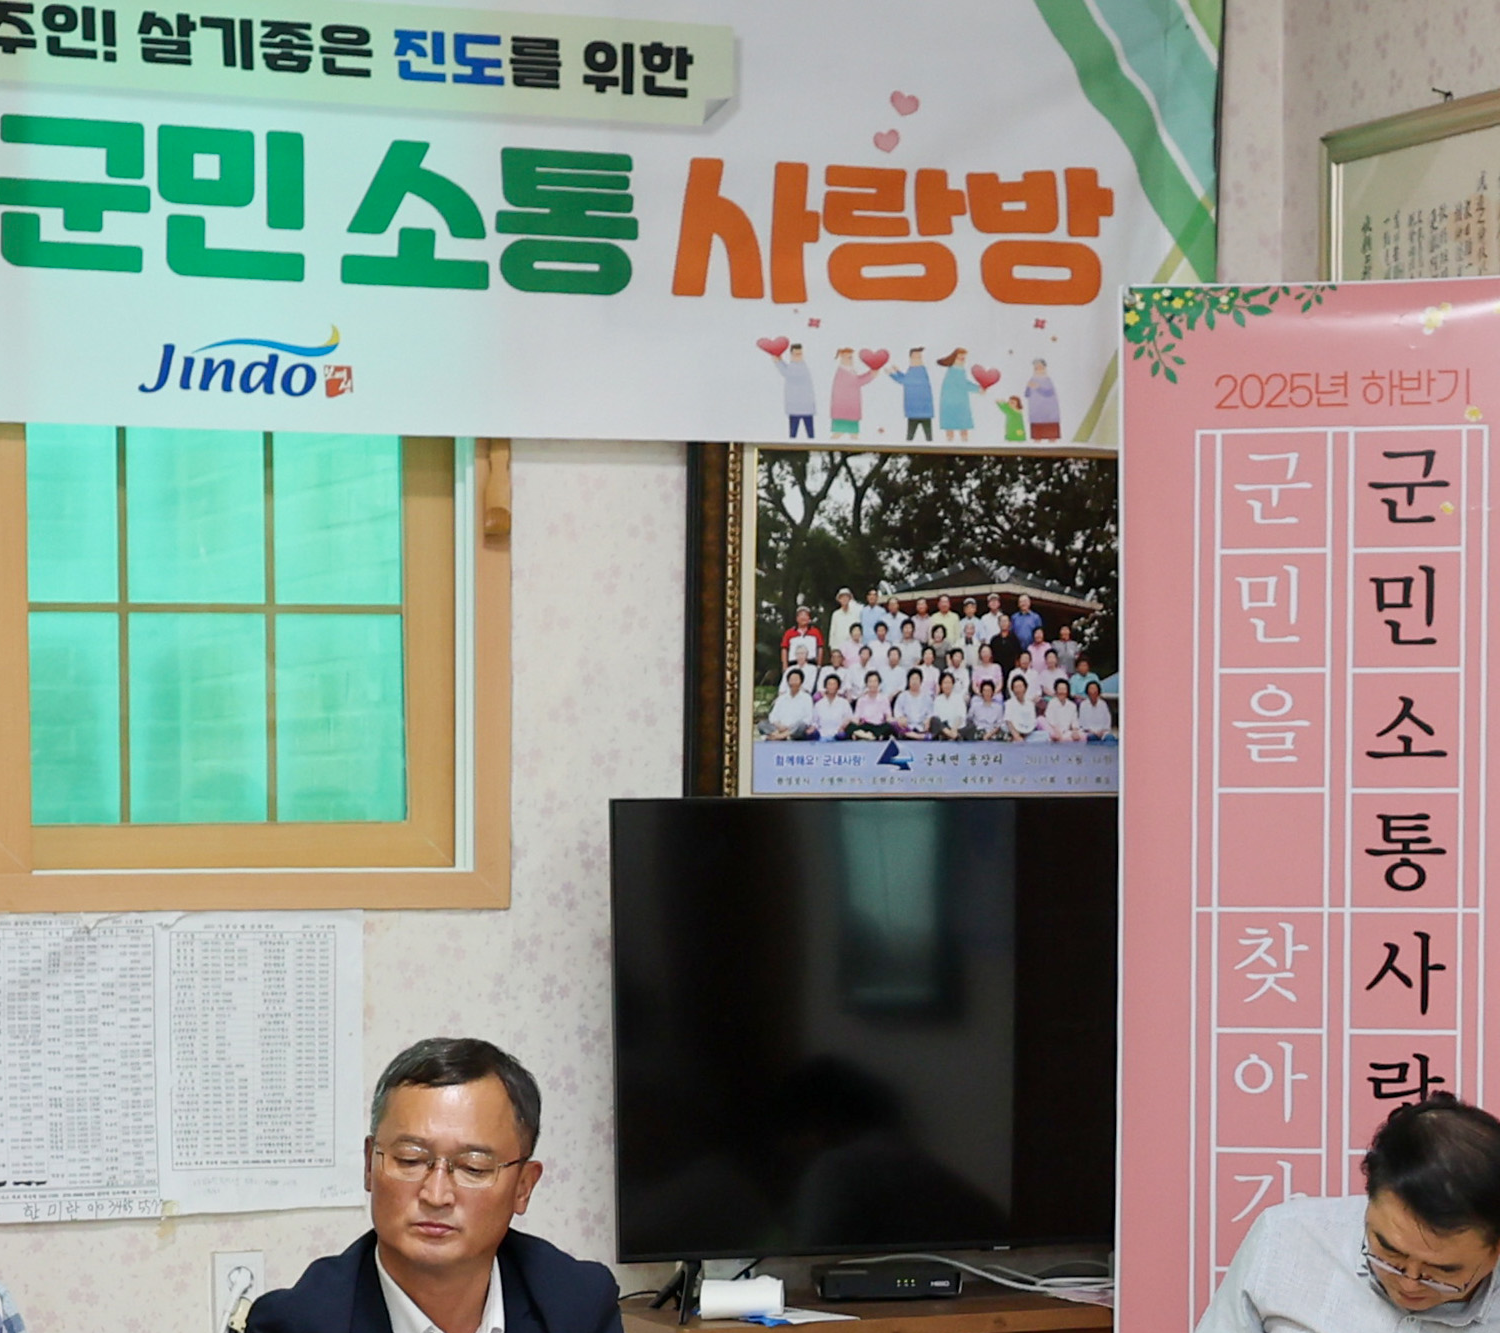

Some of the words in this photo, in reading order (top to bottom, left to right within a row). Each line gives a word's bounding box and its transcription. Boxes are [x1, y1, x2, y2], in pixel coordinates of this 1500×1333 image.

[137, 11, 373, 78] 살기좋은
[392, 33, 562, 92] 진도를
[583, 37, 695, 99] 위한
[340, 138, 640, 298] 소통
[670, 155, 1115, 305] 사랑방
[138, 343, 317, 397] Jindo
[1214, 371, 1349, 410] 2025년
[1361, 368, 1471, 407] 하반기
[1232, 450, 1313, 765] 군민을
